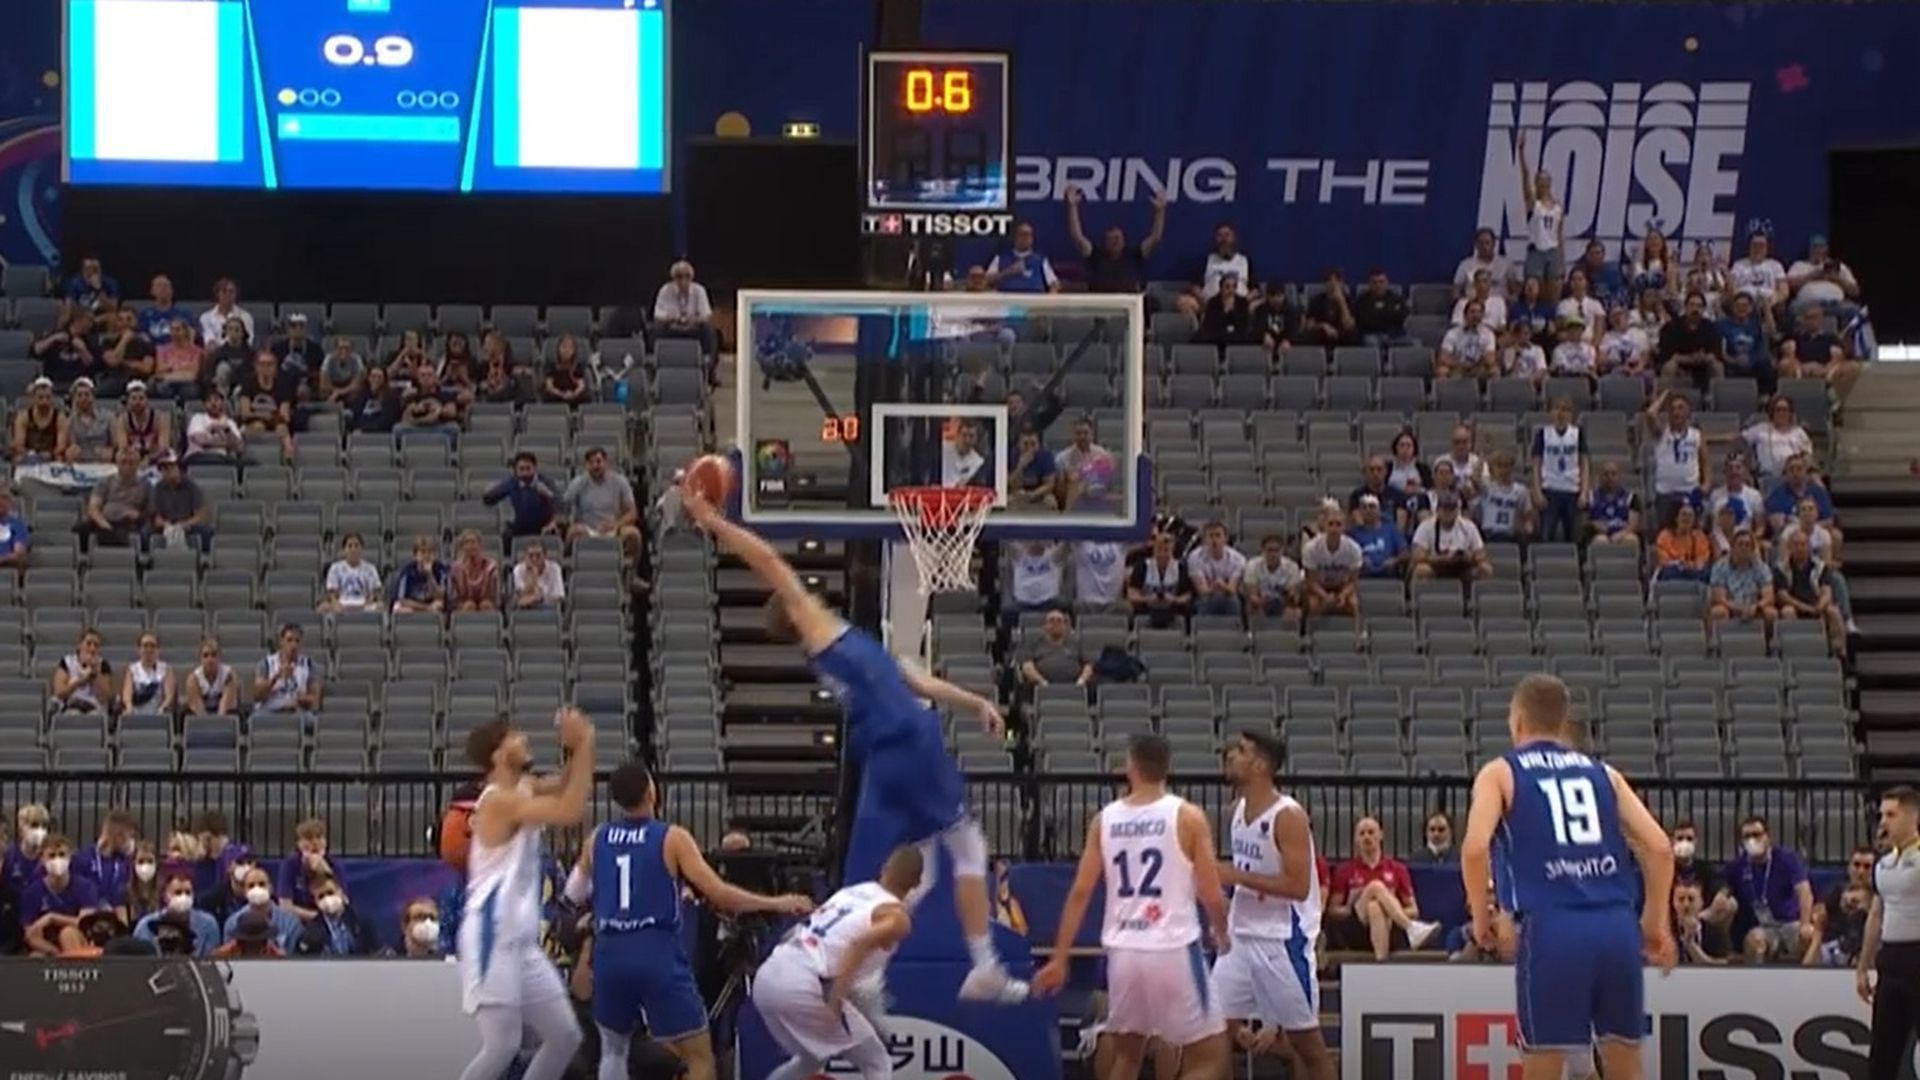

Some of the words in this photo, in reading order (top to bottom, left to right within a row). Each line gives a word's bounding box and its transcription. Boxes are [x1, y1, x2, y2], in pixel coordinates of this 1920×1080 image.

[324, 35, 413, 66] 0.9
[907, 70, 970, 111] 0.6
[1015, 156, 1237, 203] BRING
[1267, 159, 1430, 205] THE
[1477, 82, 1750, 250] NOISE
[904, 214, 1013, 235] TISSOT
[1537, 776, 1603, 845] 19
[616, 854, 631, 910] 1
[1113, 847, 1163, 898] 12
